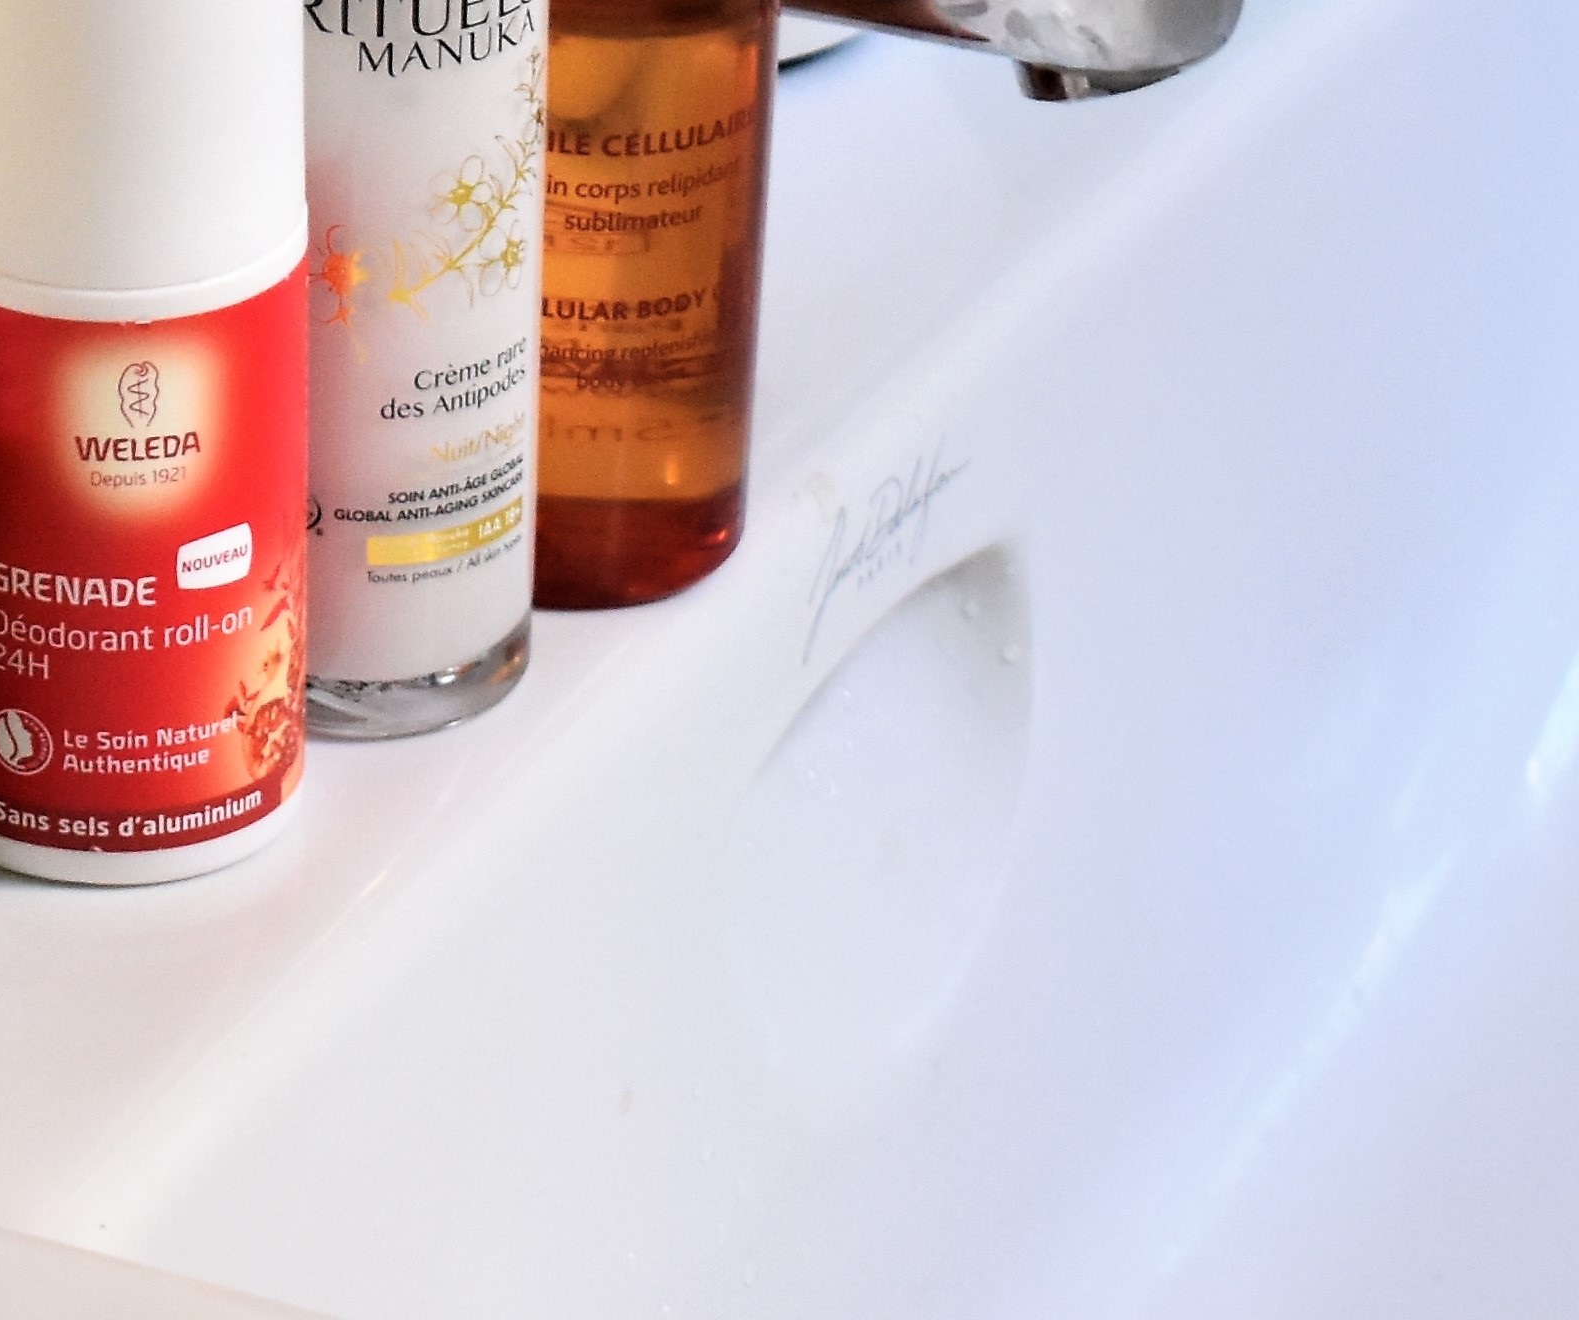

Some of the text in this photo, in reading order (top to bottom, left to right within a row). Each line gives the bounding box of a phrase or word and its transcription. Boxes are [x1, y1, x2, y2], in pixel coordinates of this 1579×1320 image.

[357, 8, 535, 79] MANUKA
[547, 131, 592, 156] ILE
[575, 180, 641, 205] corps
[563, 204, 704, 233] sublimateur
[541, 289, 706, 321] LULAR BODY
[413, 357, 492, 391] Crème
[380, 367, 526, 420] des Antipodes
[74, 430, 202, 463] WELEDA
[90, 466, 188, 490] Depuis 1921
[333, 494, 480, 523] GLOBAL ANTI-AGING
[388, 491, 425, 505] SOIN
[180, 543, 249, 574] NOUVEAU
[366, 570, 408, 584] Toutes
[162, 604, 253, 649] roll-on
[62, 710, 239, 751] Le Soin Naturel
[62, 746, 211, 775] Authentique
[58, 817, 110, 838] sels
[117, 789, 263, 839] d'aluminium
